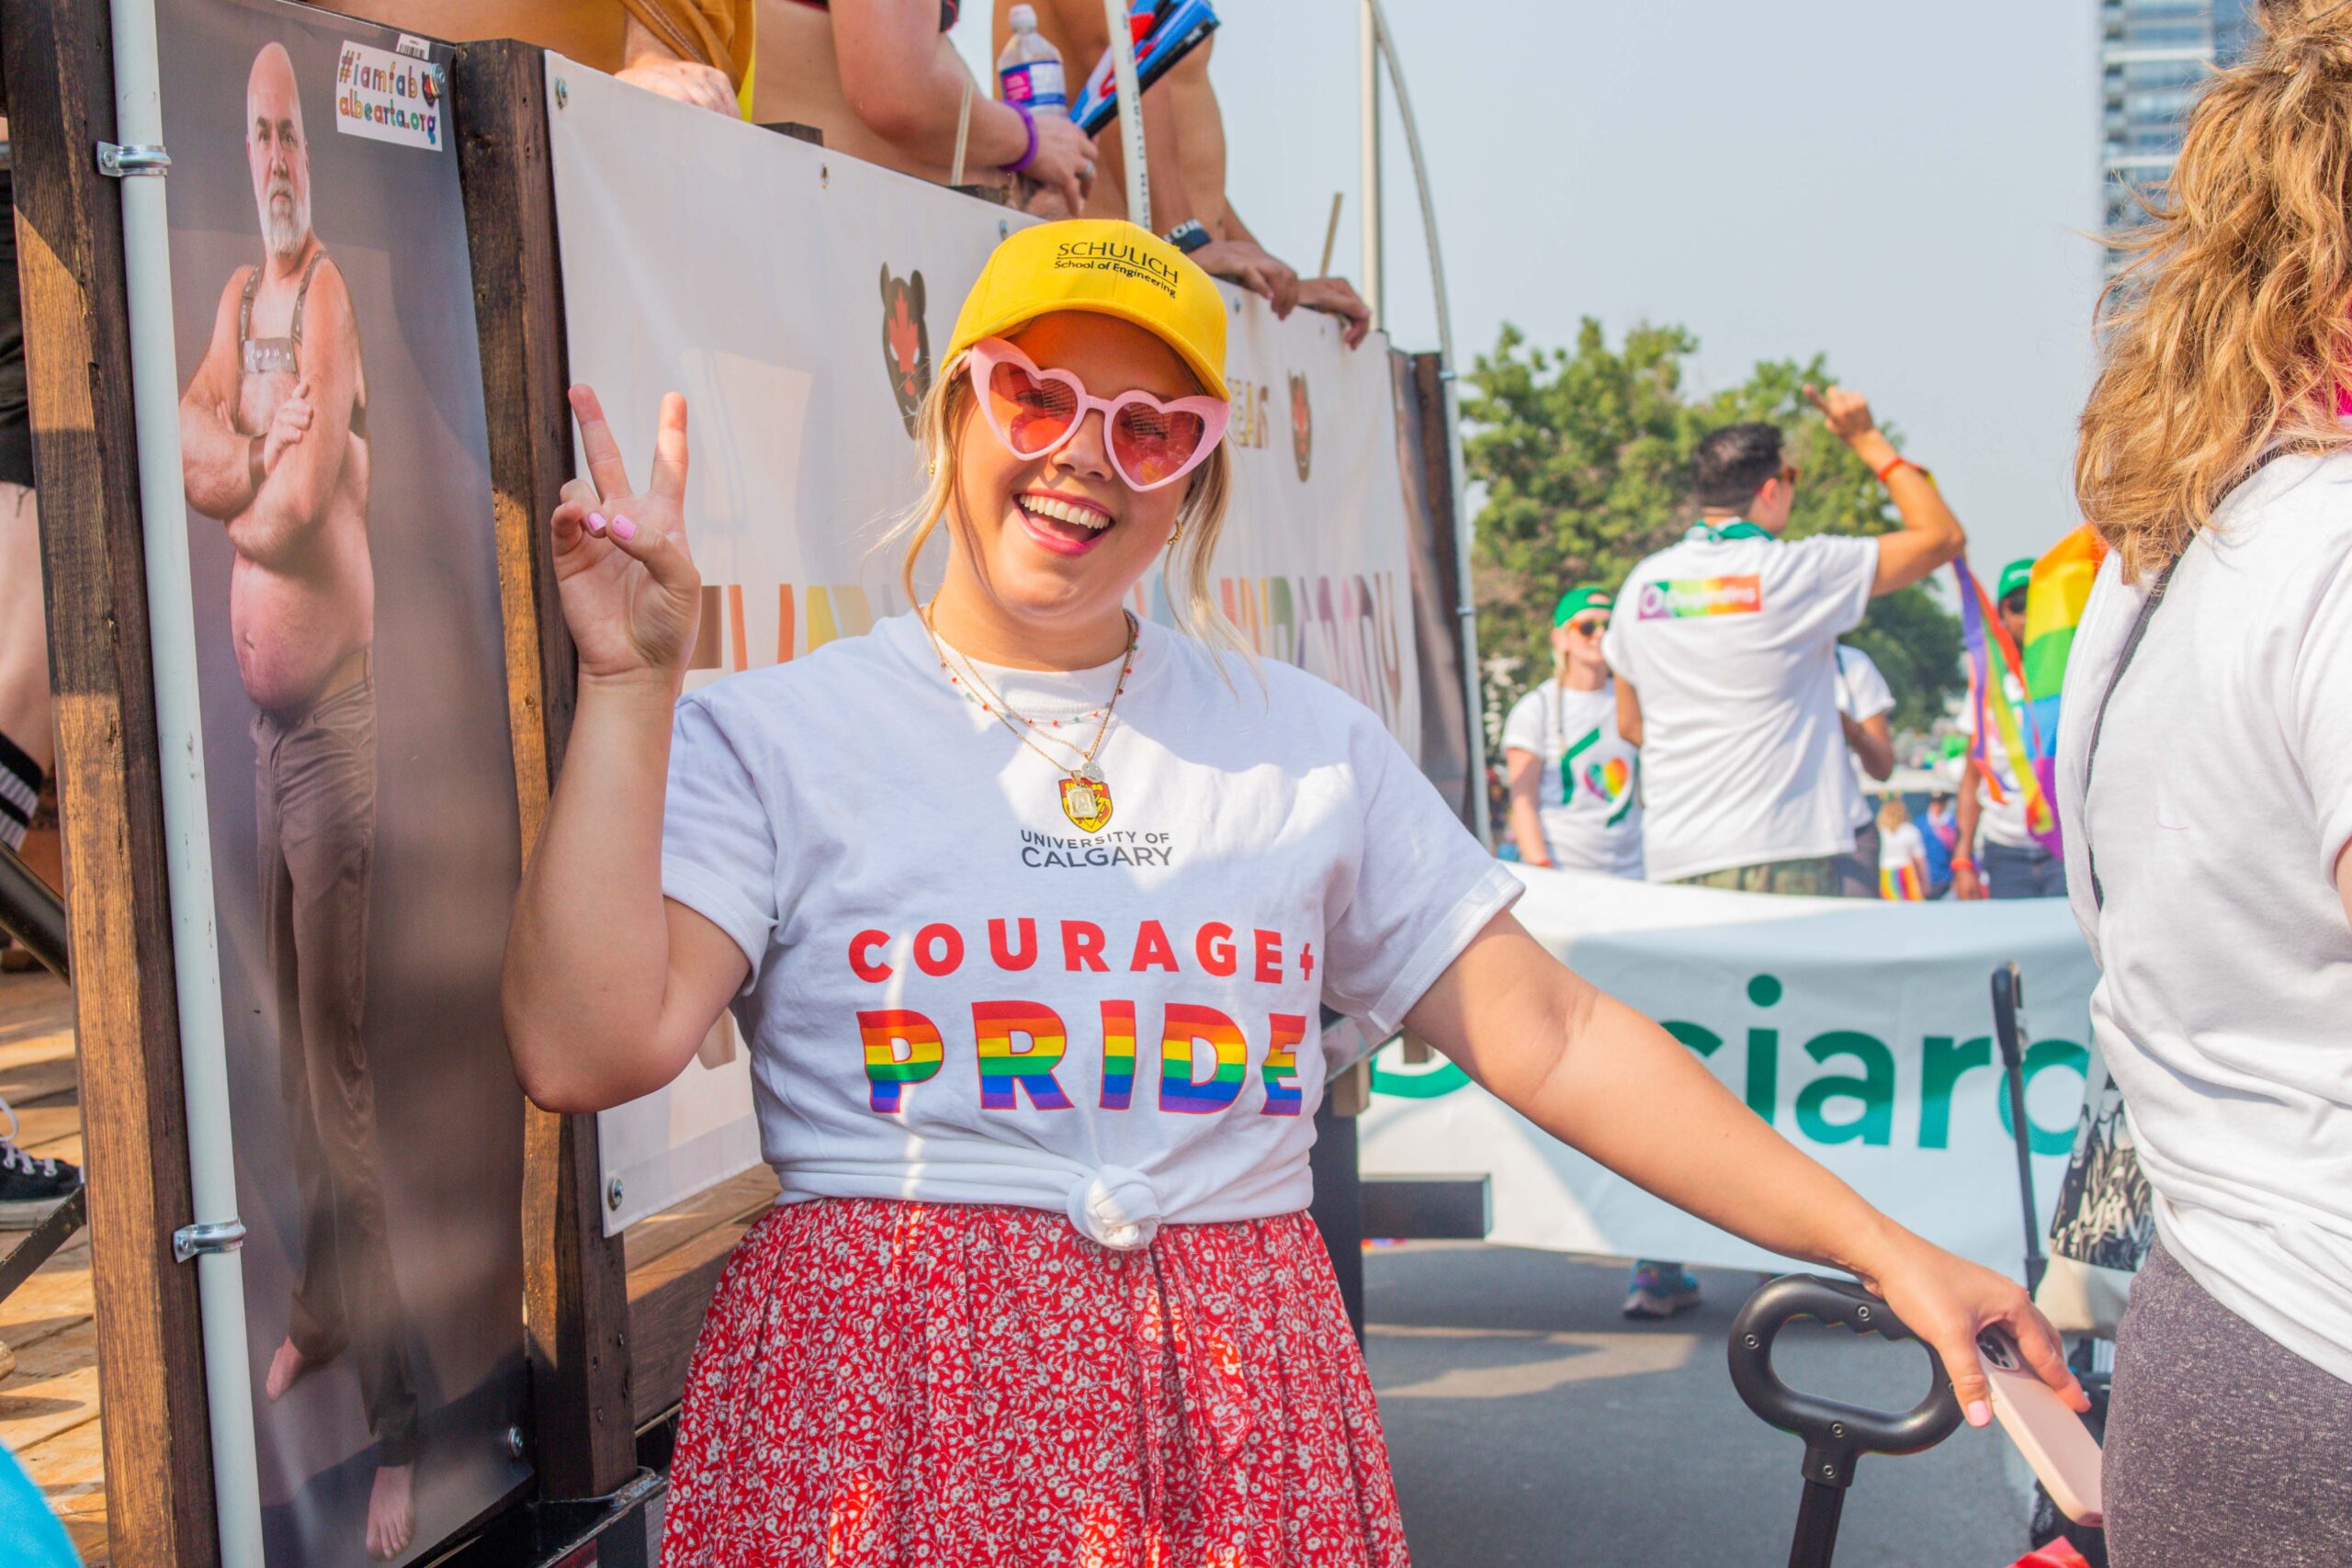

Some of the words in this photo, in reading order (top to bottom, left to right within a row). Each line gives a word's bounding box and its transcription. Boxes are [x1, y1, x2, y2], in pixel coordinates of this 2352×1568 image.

[339, 50, 418, 98] #iamfab
[339, 89, 436, 144] albearta.org
[1055, 260, 1094, 269] School
[1113, 263, 1176, 299] Engineering
[1057, 242, 1178, 284] SCHULICH
[1021, 829, 1136, 849] UNIVERSITY
[1145, 832, 1169, 844] OF
[1021, 846, 1172, 868] CALGARY
[855, 999, 1306, 1117] PRIDE
